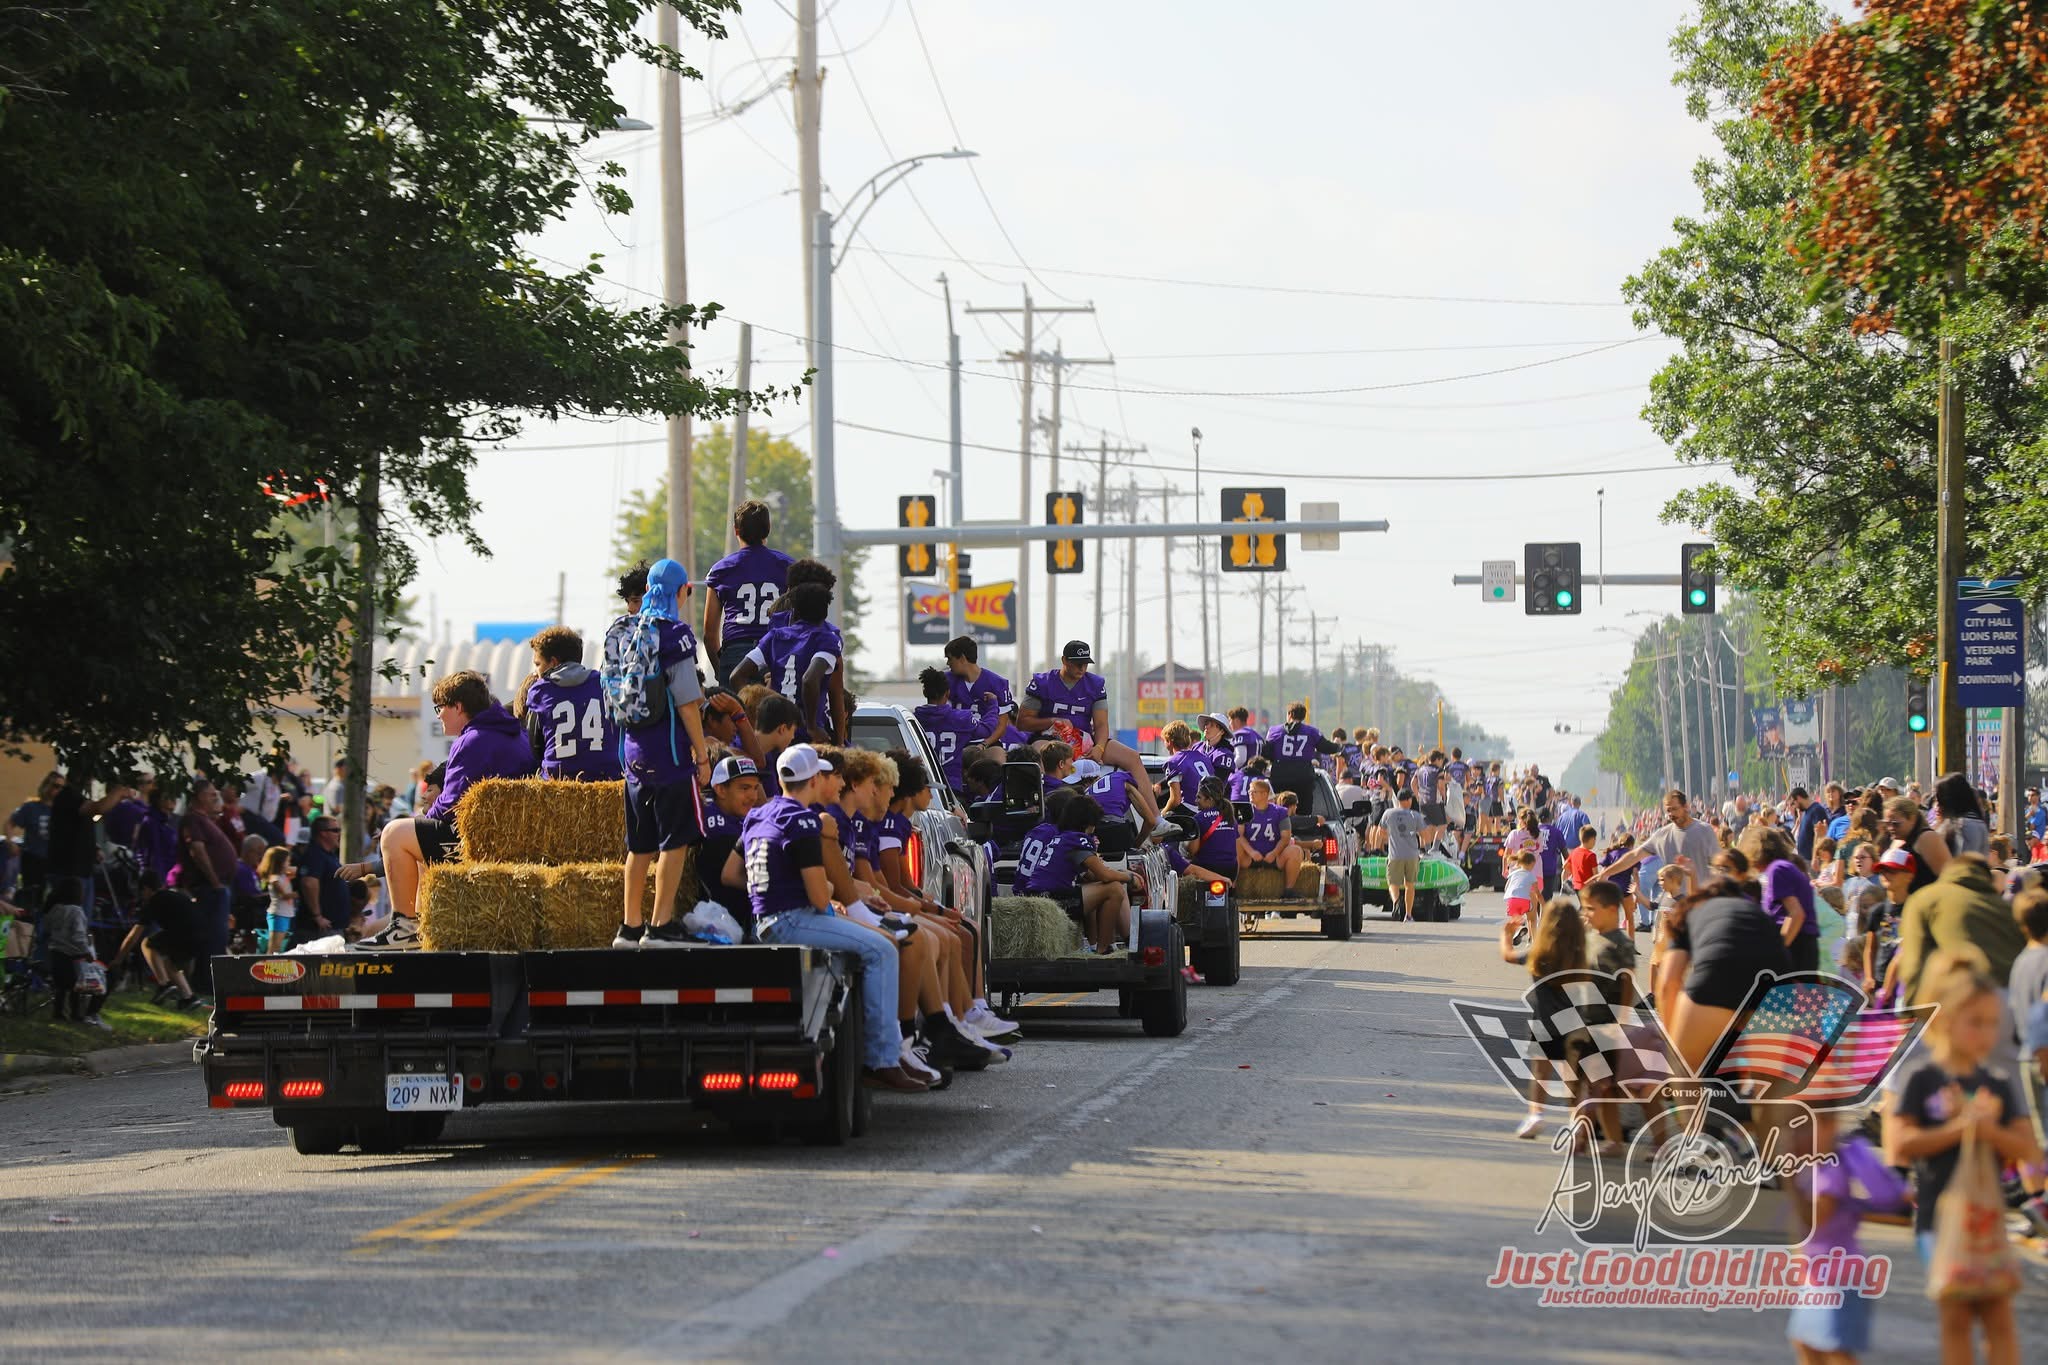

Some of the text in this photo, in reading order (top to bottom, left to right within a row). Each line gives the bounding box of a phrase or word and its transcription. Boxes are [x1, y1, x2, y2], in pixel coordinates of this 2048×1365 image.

[736, 582, 780, 625] 32
[1964, 617, 2014, 628] CITY HALL
[1960, 631, 2018, 641] LIONS PARK
[1963, 645, 2017, 655] VETERANS
[1964, 656, 1993, 666] PARK
[1958, 675, 2012, 685] DOWNTOWN
[551, 697, 604, 759] 24
[1281, 734, 1308, 757] 67
[1220, 756, 1233, 768] 18
[884, 818, 895, 829] 11
[1249, 823, 1276, 842] 74
[319, 962, 394, 979] BigTex
[392, 1087, 420, 1105] 209
